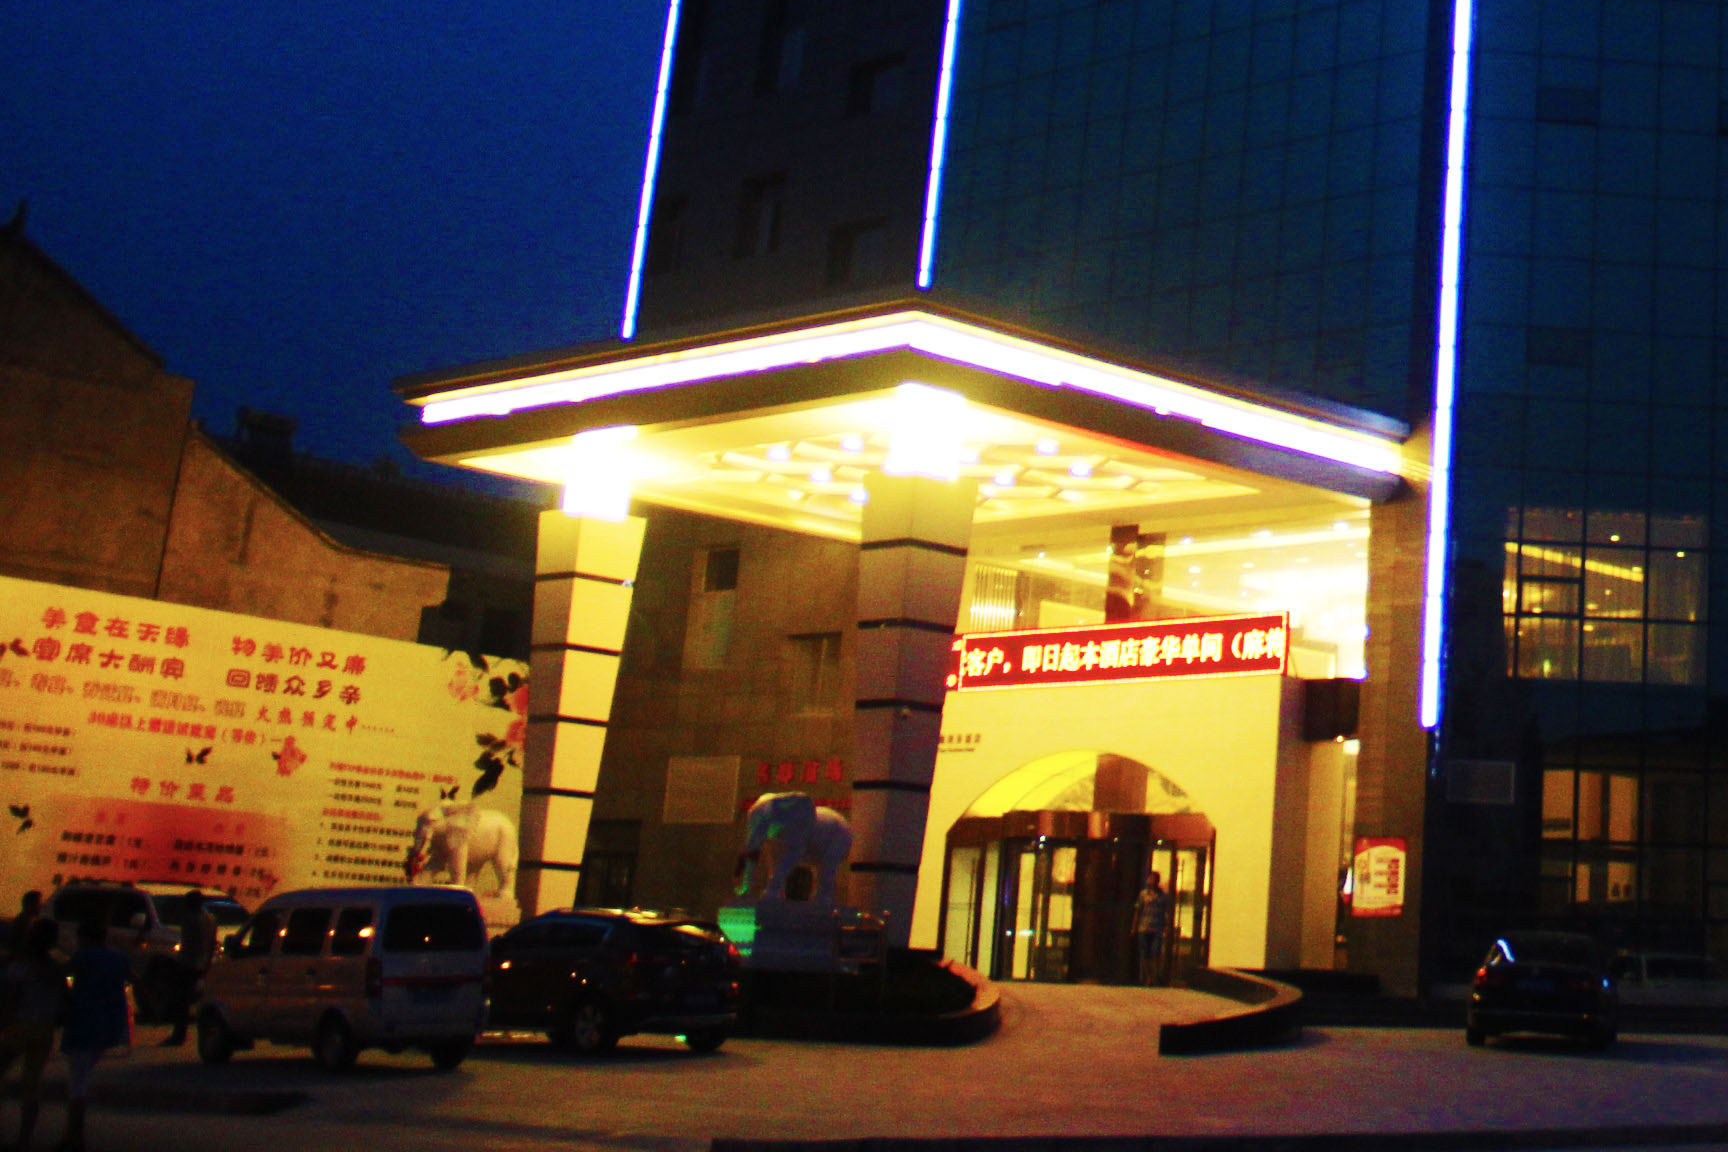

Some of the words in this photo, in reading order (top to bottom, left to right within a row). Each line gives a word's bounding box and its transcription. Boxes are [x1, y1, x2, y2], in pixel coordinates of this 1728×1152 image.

[41, 606, 190, 648] 美食在天缘
[231, 635, 367, 677] 物美价又廉
[960, 626, 1285, 678] 客户，即日起本酒店豪华单间（麻将
[226, 667, 362, 706] 回馈众乡亲
